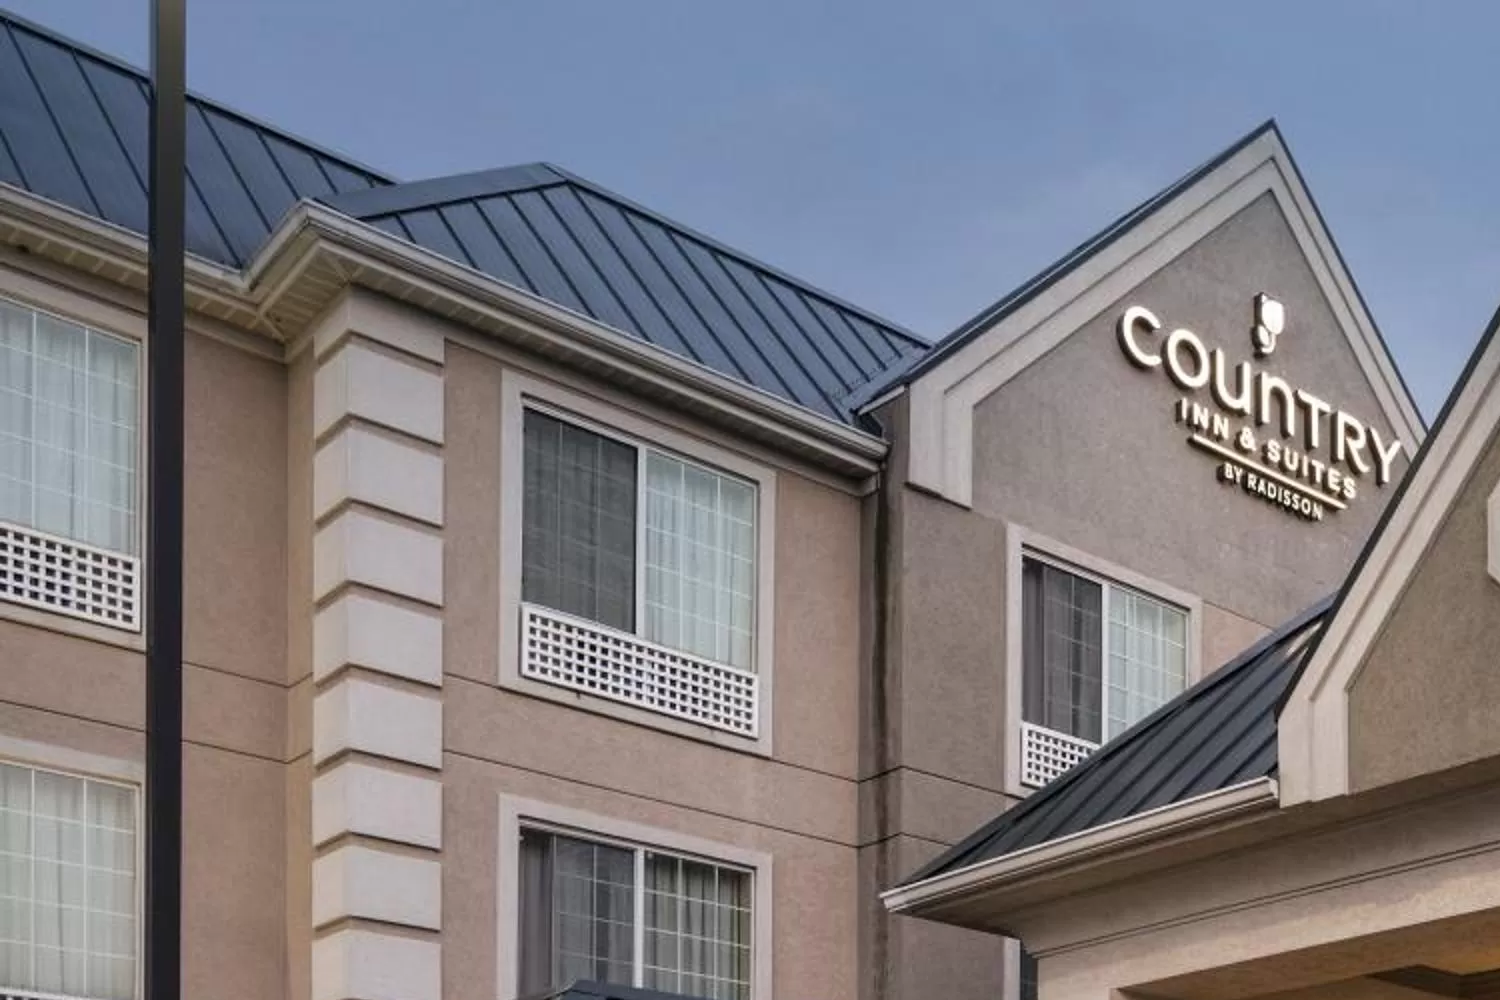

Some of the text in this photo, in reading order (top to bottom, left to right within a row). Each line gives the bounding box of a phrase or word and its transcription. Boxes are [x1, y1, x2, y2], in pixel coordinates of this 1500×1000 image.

[1178, 397, 1358, 499] INN & SUITES
[1223, 462, 1323, 521] BY RADISSON
